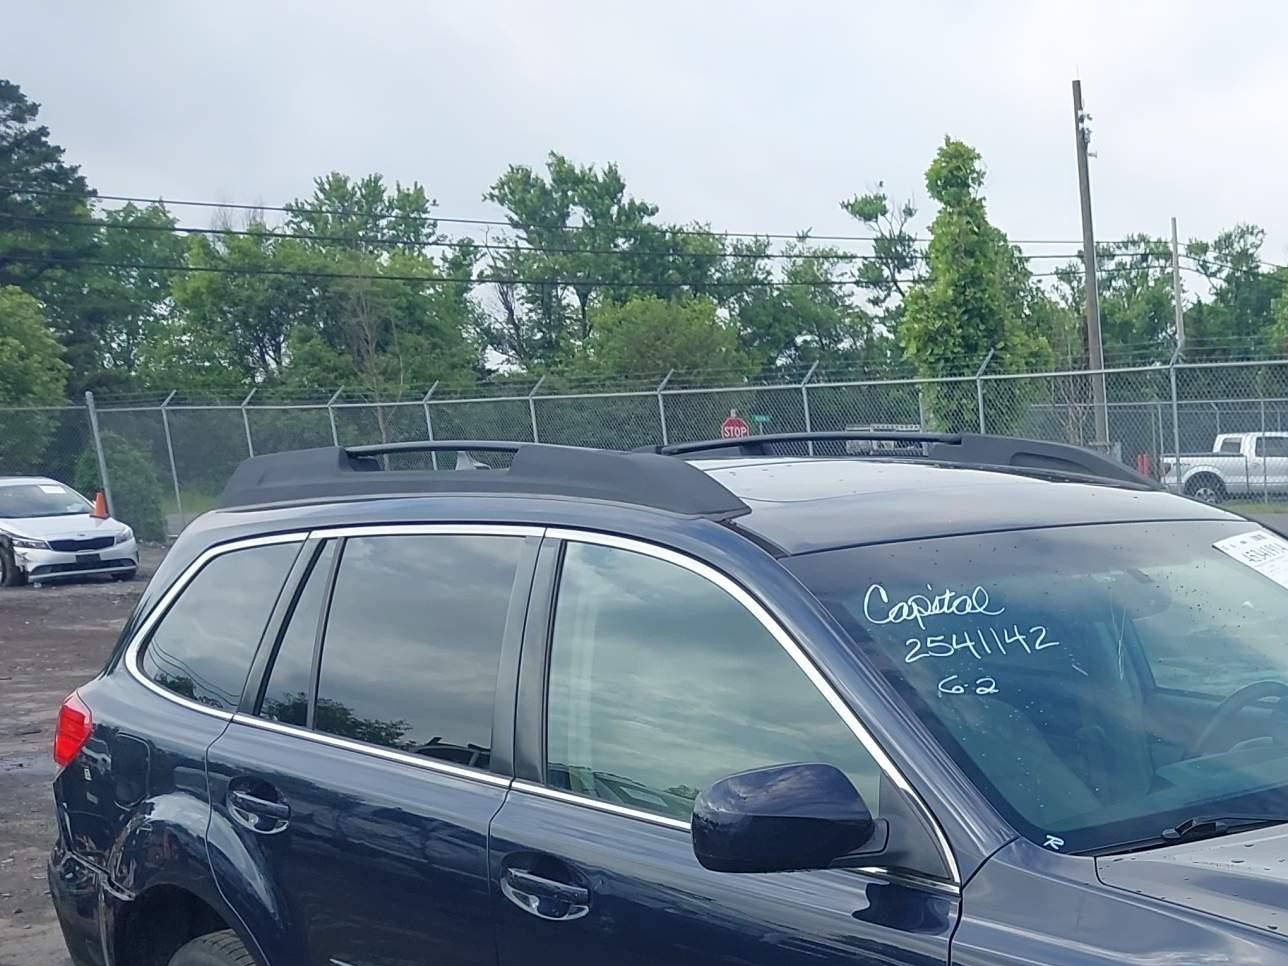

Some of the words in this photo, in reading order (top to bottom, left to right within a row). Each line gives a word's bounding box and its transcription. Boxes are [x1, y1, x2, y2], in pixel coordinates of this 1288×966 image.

[724, 426, 747, 438] STOP
[863, 583, 1005, 630] Capital
[904, 624, 1060, 663] 2541142
